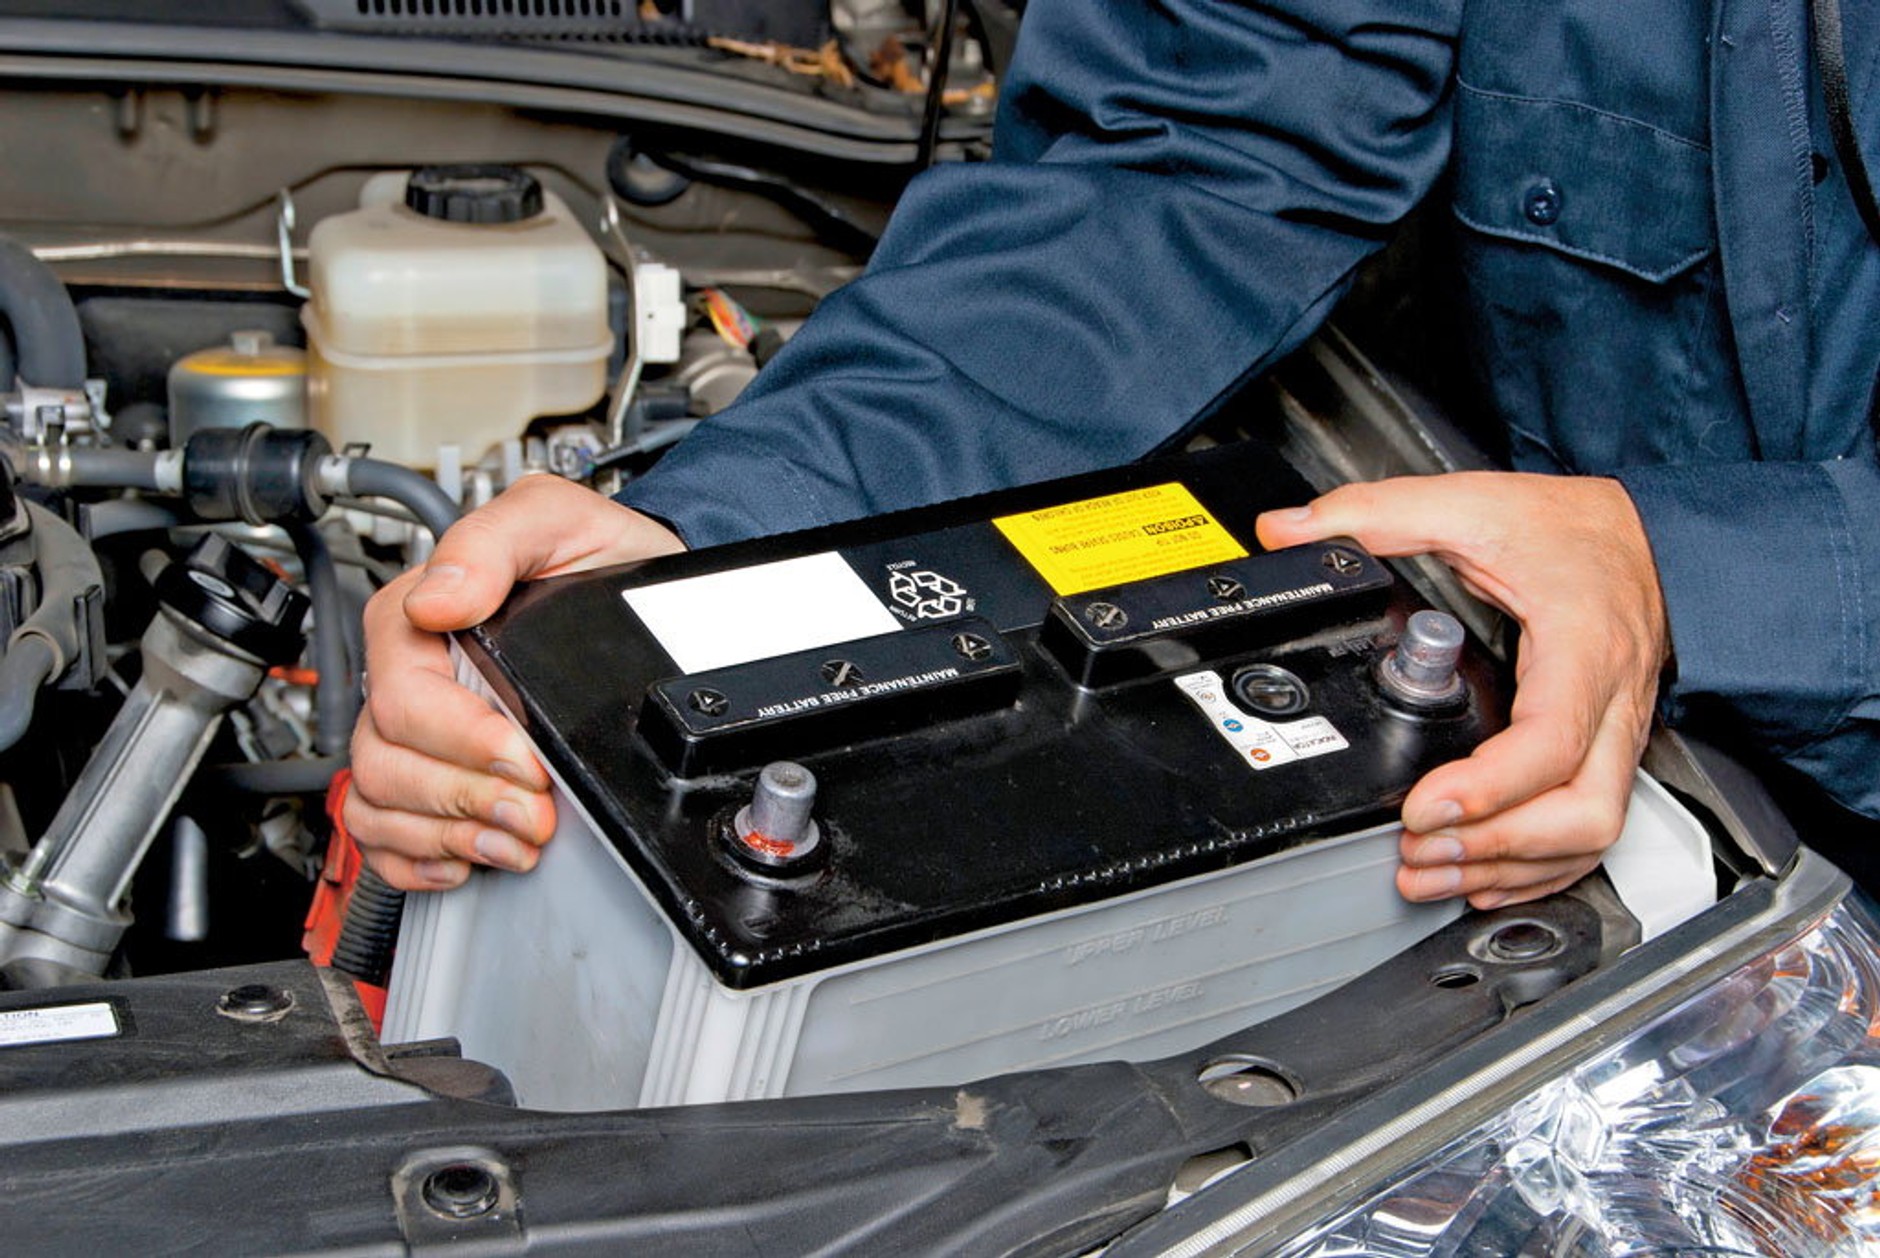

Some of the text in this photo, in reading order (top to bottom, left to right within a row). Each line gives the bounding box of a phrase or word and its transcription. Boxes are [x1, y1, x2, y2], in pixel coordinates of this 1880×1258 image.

[1146, 518, 1194, 534] POISON
[1152, 582, 1334, 630] MAINTENANCE FREE BATTERY
[757, 667, 959, 718] MAINTENANCE FREE BATTERY
[1066, 905, 1228, 967] UPPER LEVEL
[1040, 982, 1206, 1041] LOWER LEVEL
